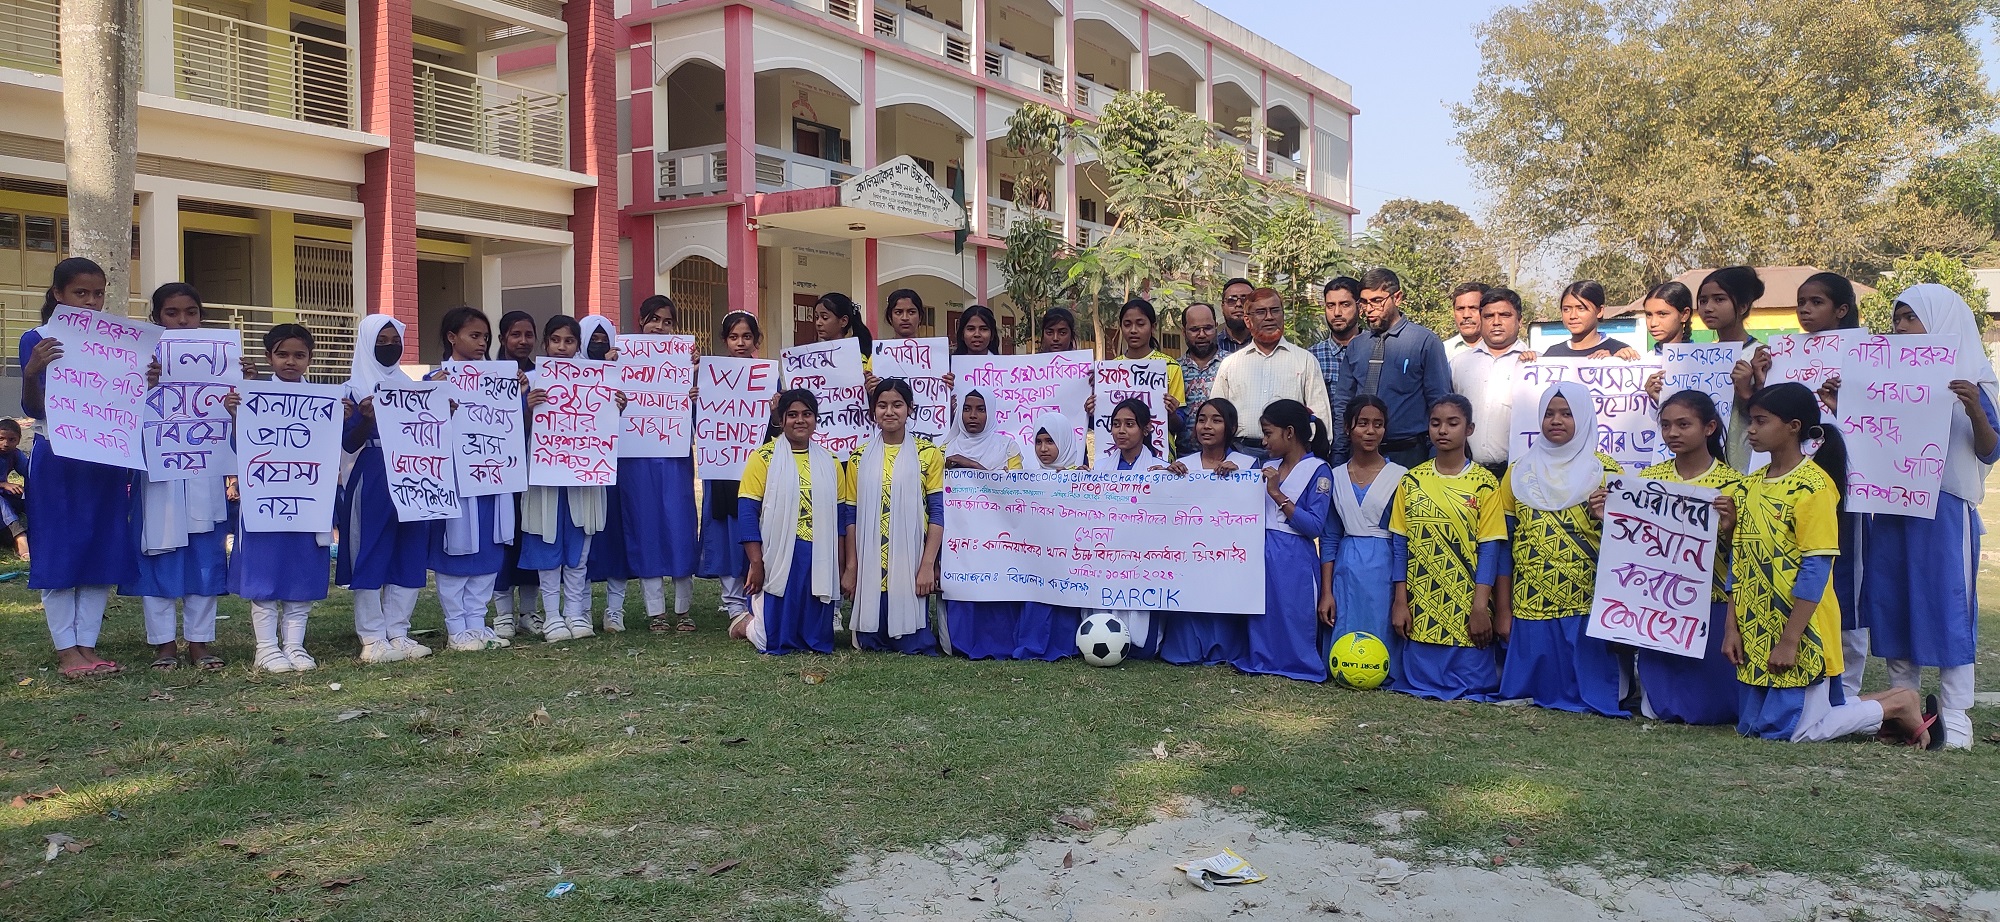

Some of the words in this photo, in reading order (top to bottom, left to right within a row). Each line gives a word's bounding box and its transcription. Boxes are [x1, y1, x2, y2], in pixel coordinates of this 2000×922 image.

[855, 166, 894, 193] কালিয়াকৈর
[895, 162, 910, 176] খান
[910, 162, 923, 184] উচ্চ
[923, 175, 951, 211] বিদ্যালয়
[57, 310, 93, 334] নারী
[96, 319, 143, 343] পুরুষ
[81, 341, 138, 370] সমতার
[1848, 335, 1891, 369] নারী
[1900, 346, 1957, 367] পুরুষ
[51, 366, 109, 397] সমাজ
[541, 360, 617, 382] সকল
[657, 361, 692, 384] শিশু
[708, 363, 771, 392] WE
[791, 375, 826, 391] হোক
[965, 363, 1008, 387] নারীর
[1130, 363, 1167, 390] মিলে
[1524, 365, 1569, 386] নয়
[1664, 372, 1704, 390] আগে
[49, 394, 77, 413] সম
[621, 389, 691, 411] আমাদের
[1866, 381, 1930, 405] সমতা
[246, 392, 337, 422] কন্যাদের
[699, 397, 771, 418] WANT
[55, 424, 87, 443] বাস
[93, 428, 131, 458] করি
[144, 413, 233, 447] বিয়ে
[246, 423, 311, 448] প্রতি
[399, 412, 448, 449] নারী
[621, 415, 684, 445] সম্পদ
[1843, 415, 1902, 448] সমৃদ্ধ
[462, 433, 506, 456] হ্রাস
[161, 450, 213, 475] নয়
[392, 451, 450, 481] জাগো
[533, 448, 590, 469] নিশ্চিত
[574, 459, 617, 484] করি
[1846, 472, 1931, 509] নিশ্চয়তা
[256, 497, 316, 521] নয়
[1004, 499, 1027, 514] নারী
[1030, 502, 1055, 517] দিবস
[1058, 504, 1106, 521] উপলক্ষে
[1108, 507, 1167, 525] কিশোরীদের
[1172, 506, 1204, 526] প্রীতি
[1210, 509, 1259, 528] ফুটবল
[1074, 526, 1115, 543] খেলা
[1608, 511, 1712, 573] সম্মান
[1046, 546, 1067, 558] খান
[1071, 543, 1092, 561] উচ্চ
[1094, 543, 1141, 563] বিদ্যালয়
[1192, 542, 1247, 564] সিংগাইর
[1007, 567, 1045, 587] বিদ্যালয়
[1048, 578, 1089, 596] কর্তৃপক্ষ
[1611, 562, 1705, 610] করতে
[1101, 587, 1181, 609] BARCIK
[1341, 661, 1359, 669] LAND
